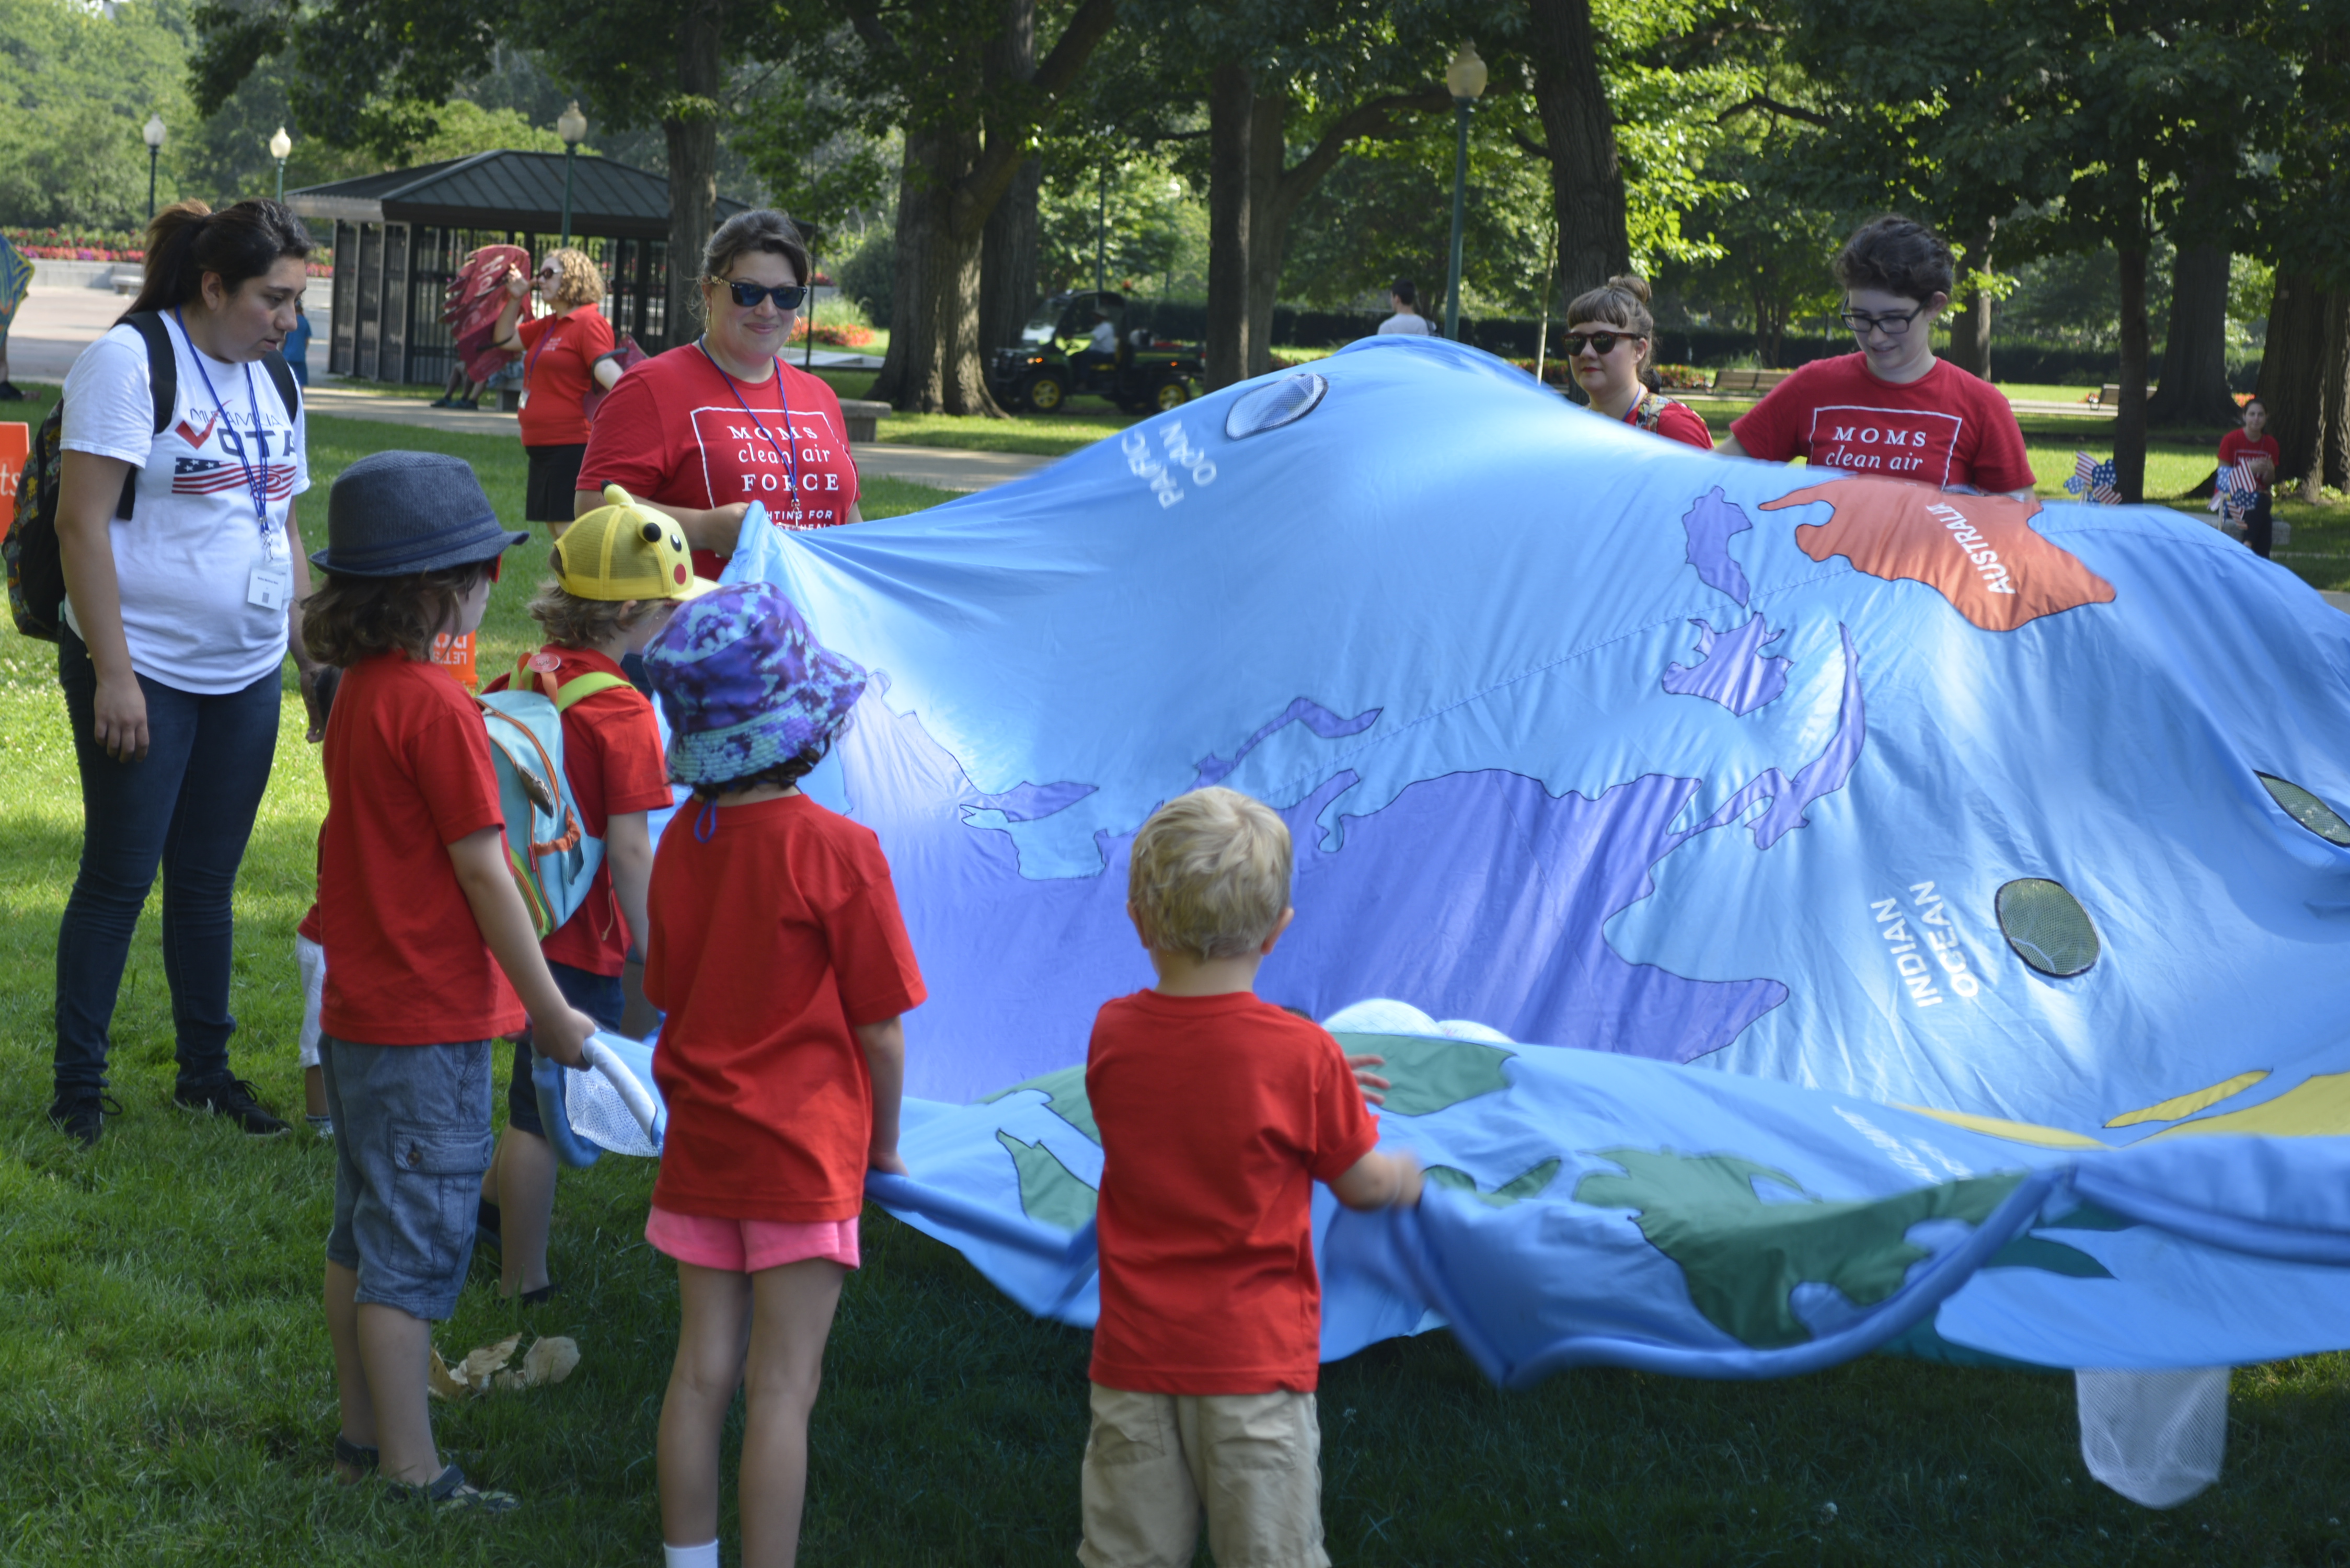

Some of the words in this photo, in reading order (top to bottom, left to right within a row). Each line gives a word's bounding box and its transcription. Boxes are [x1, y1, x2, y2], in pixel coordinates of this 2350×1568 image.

[727, 425, 818, 441] MOMS
[1832, 426, 1926, 447] MOMS
[738, 443, 792, 464] clean
[802, 444, 831, 462] air
[1826, 444, 1881, 468] clean
[1890, 452, 1923, 470] air
[766, 510, 803, 521] HTING
[809, 510, 833, 520] FOR
[1908, 880, 1979, 998] OCEAN
[1870, 897, 1943, 1008] INDIAN
